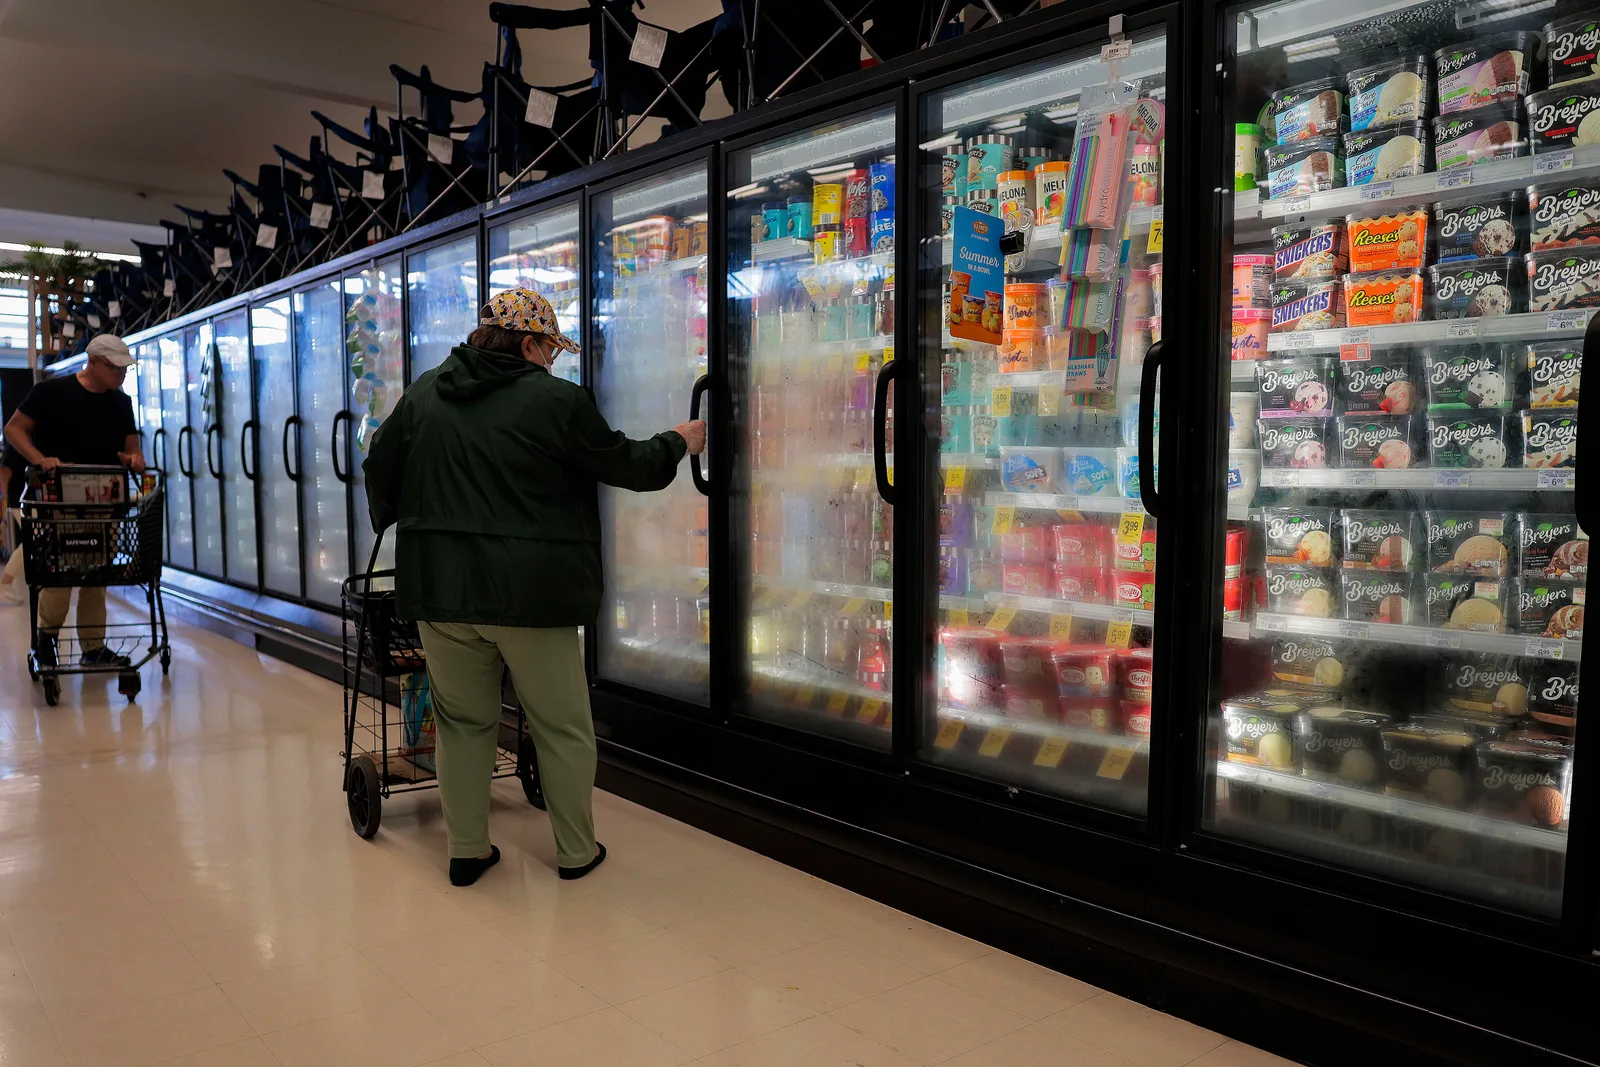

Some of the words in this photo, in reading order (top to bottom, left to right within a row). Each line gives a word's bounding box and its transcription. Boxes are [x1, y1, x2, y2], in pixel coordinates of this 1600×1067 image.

[1438, 51, 1477, 77] Breyers
[1350, 75, 1376, 95] Breyers
[1276, 93, 1300, 112] Breyers
[1136, 104, 1158, 133] MELONA
[1435, 119, 1474, 144] Breyers
[1348, 136, 1373, 156] Breyers
[1270, 153, 1294, 170] Breyers
[1441, 205, 1506, 238] Breyers
[1275, 232, 1300, 250] Breyers
[1353, 228, 1400, 247] Reese's
[960, 246, 1000, 268] Summer
[1276, 231, 1333, 269] SNICKERS
[977, 266, 991, 275] BOWL
[1273, 289, 1297, 304] Breyers
[1437, 271, 1502, 300] Breyers
[1273, 291, 1330, 326] SNICKERS
[1349, 290, 1396, 307] Reese's
[1262, 368, 1318, 393] Breyers
[1348, 367, 1408, 393] Breyers
[1431, 358, 1495, 385] Breyers
[1263, 426, 1317, 450] Breyers
[1342, 426, 1402, 450] Breyers
[1432, 424, 1496, 448] Breyers
[1123, 520, 1139, 535] 399
[1268, 519, 1324, 539] Breyers
[1347, 522, 1404, 543] Breyers
[1428, 519, 1473, 543] Breyers
[1522, 524, 1571, 547] Breyers
[1119, 545, 1139, 556] Thrifty
[1119, 587, 1140, 597] Thrifty
[1269, 574, 1325, 595] Breyers
[1346, 581, 1403, 601] Breyers
[1426, 582, 1469, 605] Breyers
[1518, 589, 1567, 612] Breyers
[1111, 630, 1127, 643] 599
[1281, 642, 1336, 662] Breyers
[1456, 665, 1521, 688] Breyers
[1227, 717, 1281, 738] Breyers
[1305, 732, 1364, 752] Breyers
[1389, 748, 1453, 771] Breyers
[1483, 765, 1556, 791] Breyers
